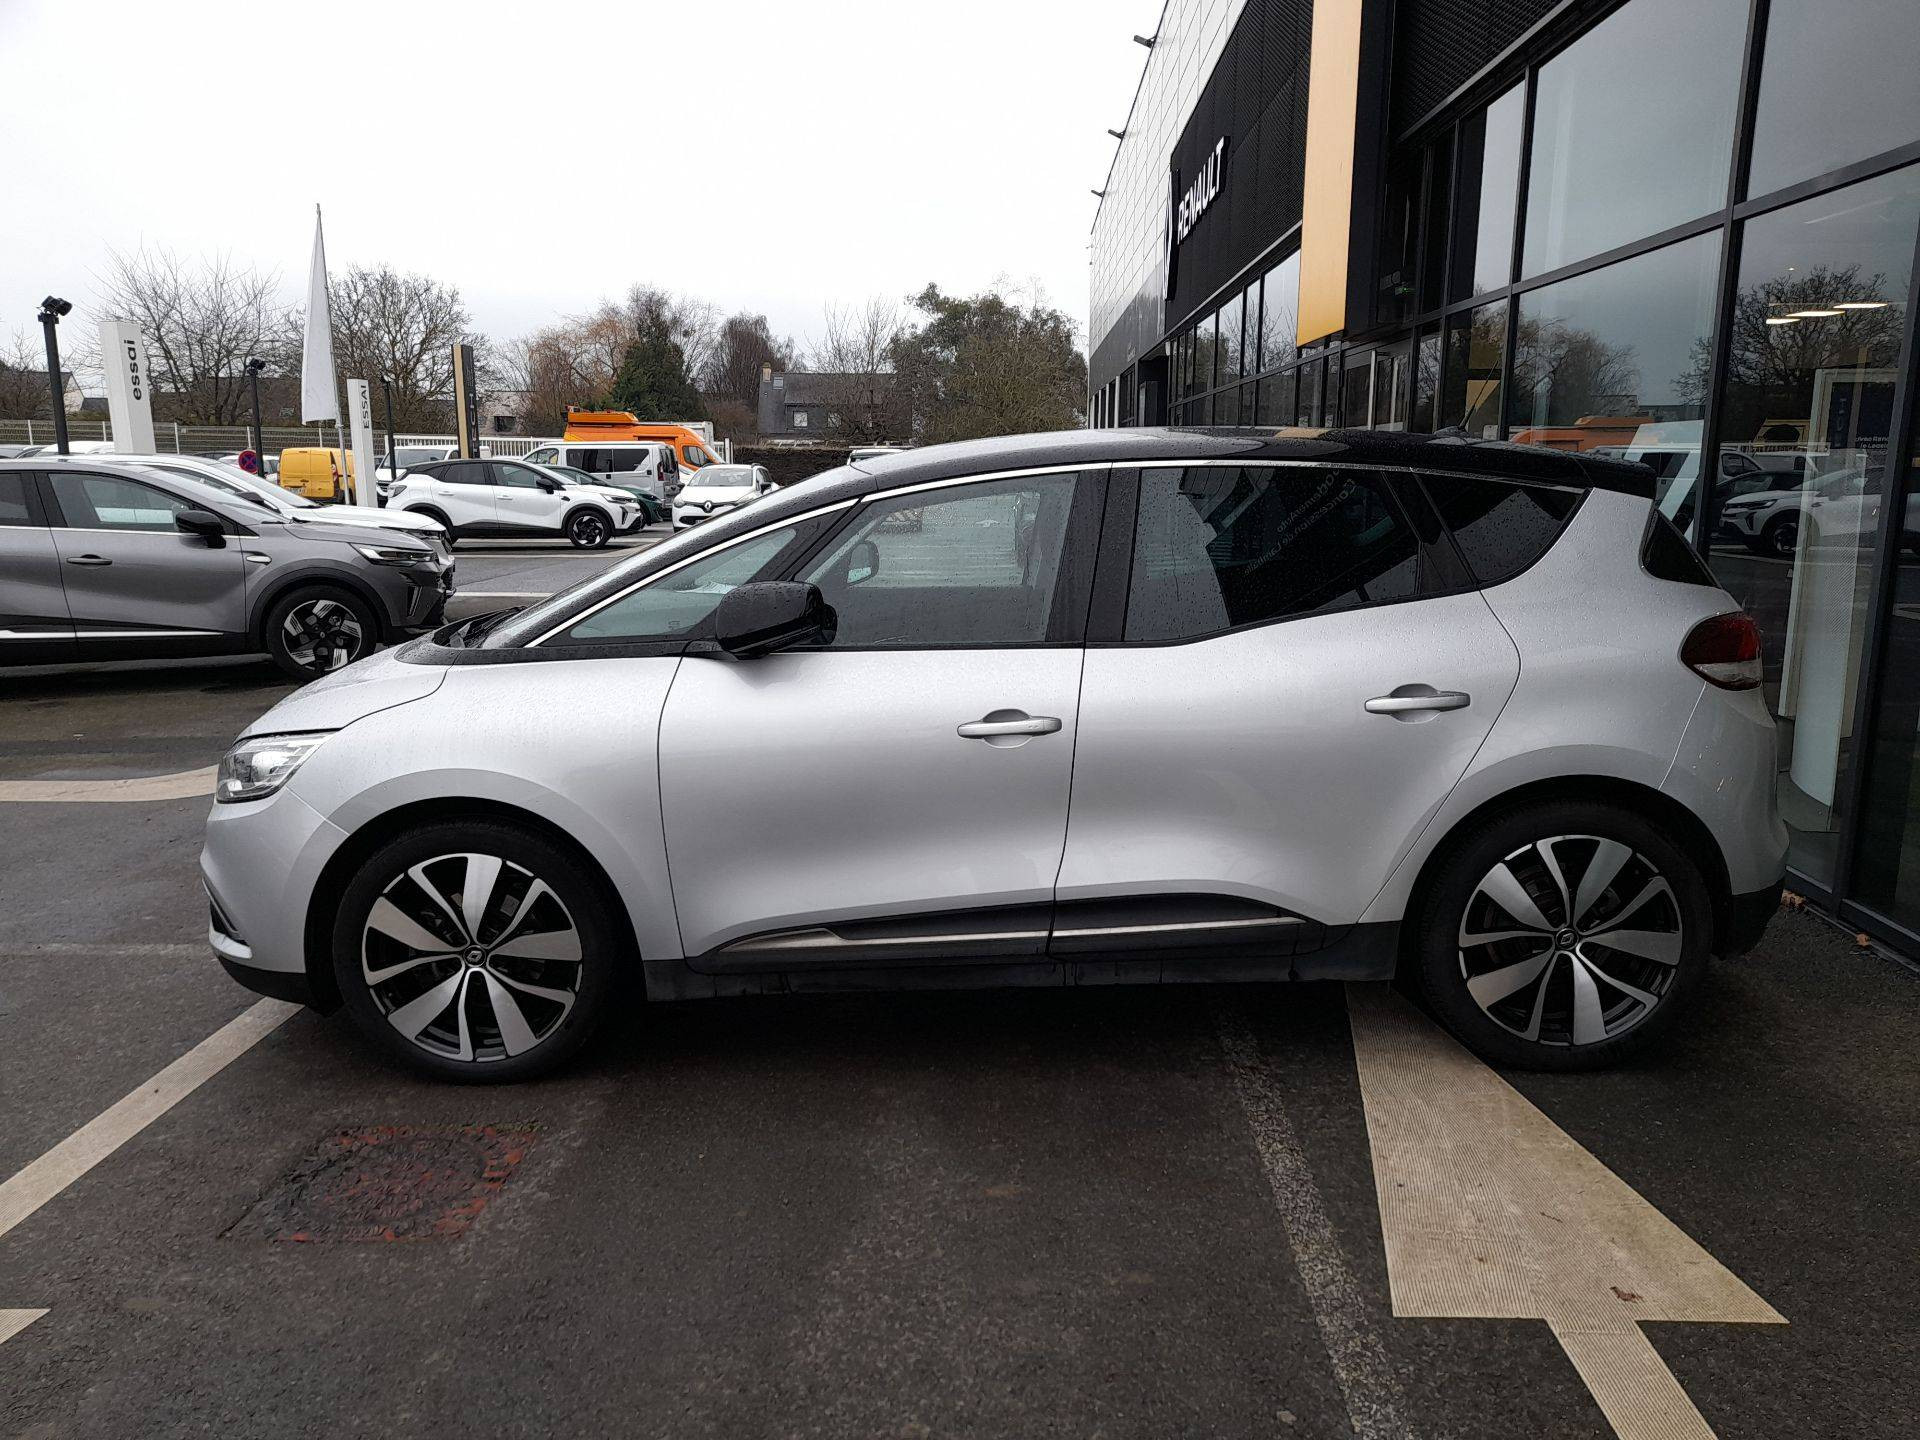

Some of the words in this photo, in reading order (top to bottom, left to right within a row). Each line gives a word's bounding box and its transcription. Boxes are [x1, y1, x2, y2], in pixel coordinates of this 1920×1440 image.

[1177, 136, 1226, 245] RENAULT
[123, 339, 142, 401] essai
[360, 384, 370, 430] ESSAI
